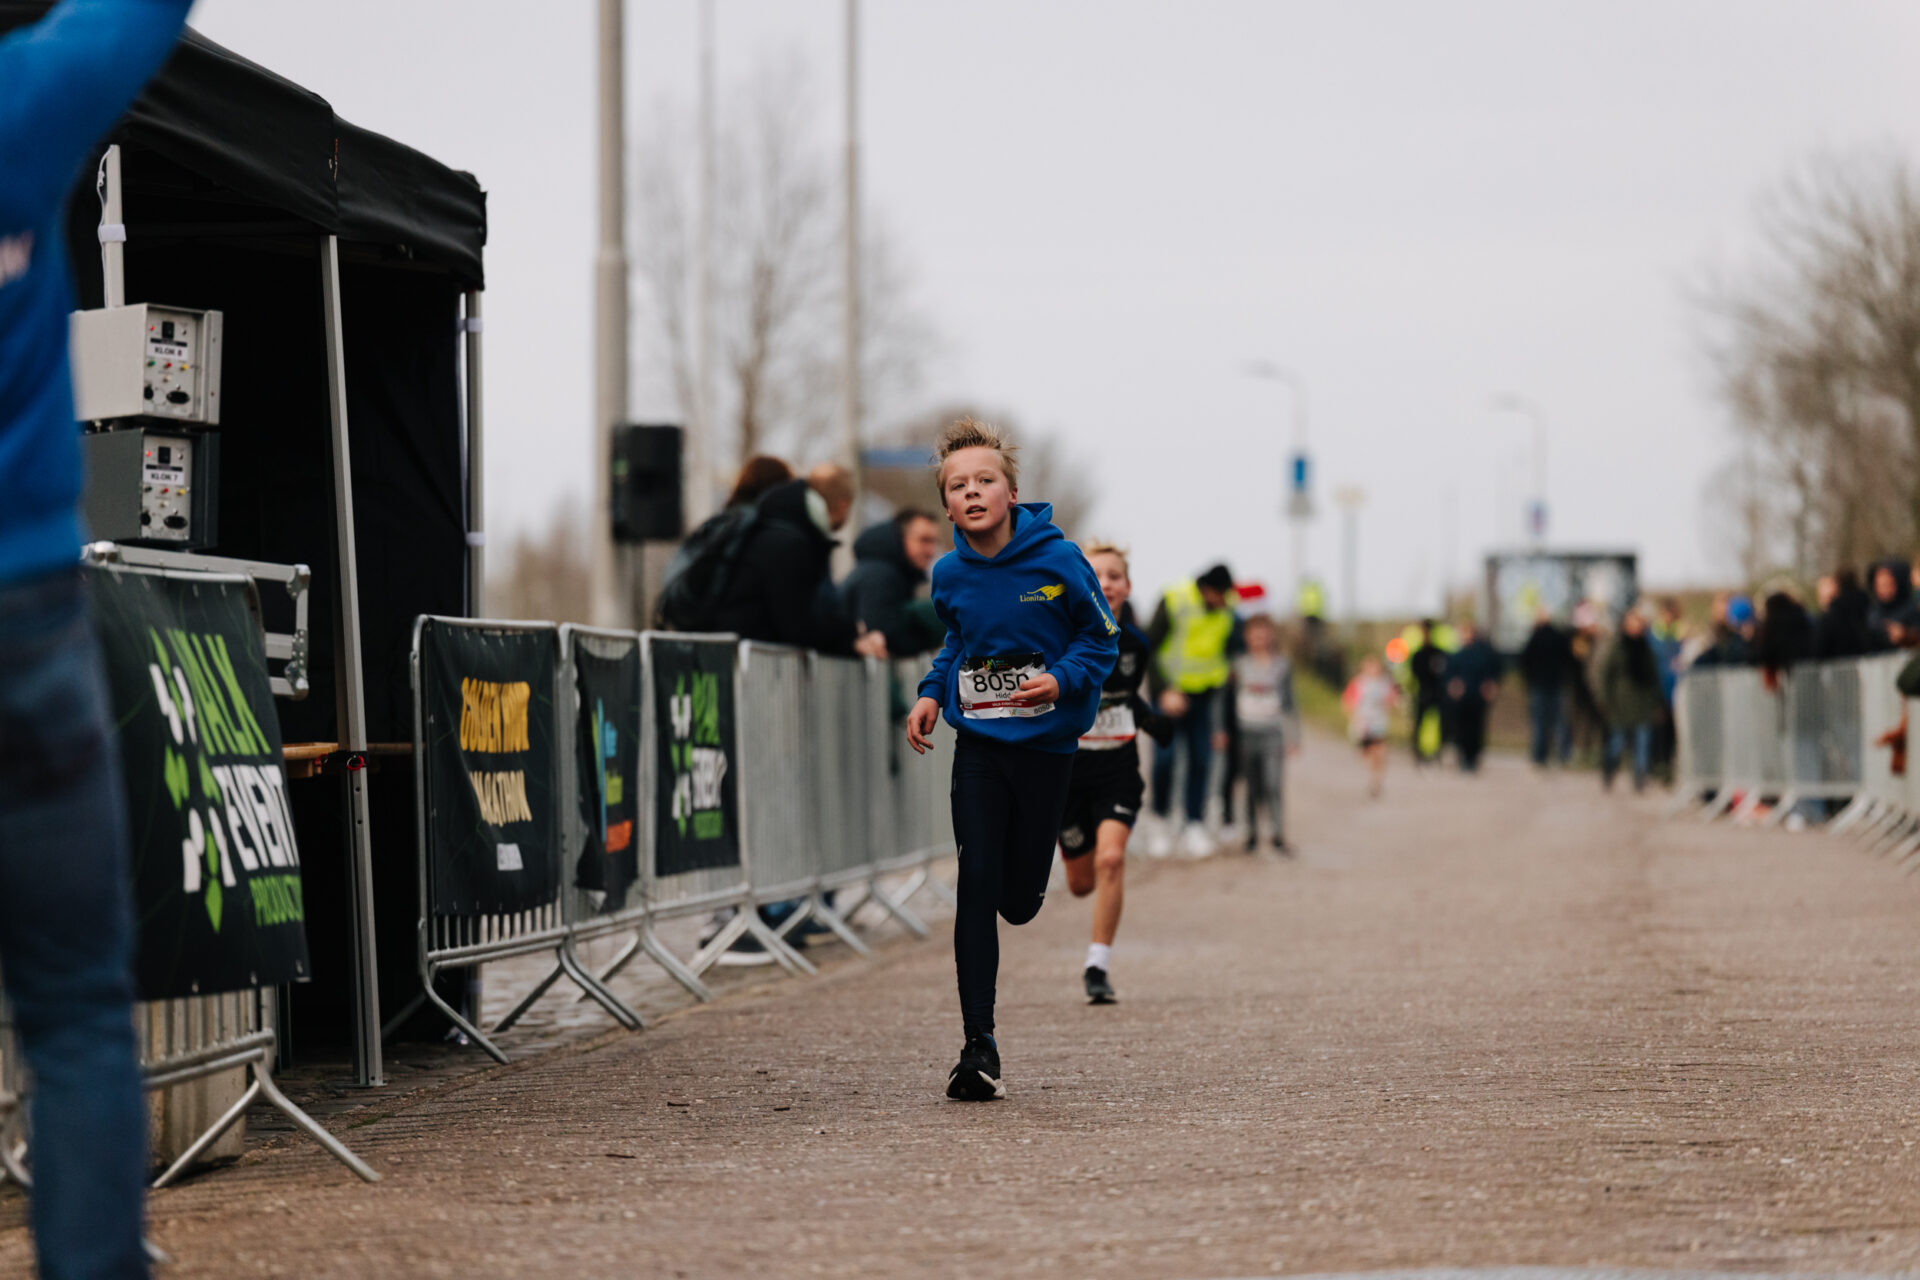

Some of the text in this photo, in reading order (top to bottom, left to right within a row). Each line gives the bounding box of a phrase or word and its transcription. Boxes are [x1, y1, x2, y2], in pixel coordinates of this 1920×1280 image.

[155, 346, 175, 355] KLOK
[151, 473, 171, 481] KLOK
[995, 691, 1011, 700] Hidd
